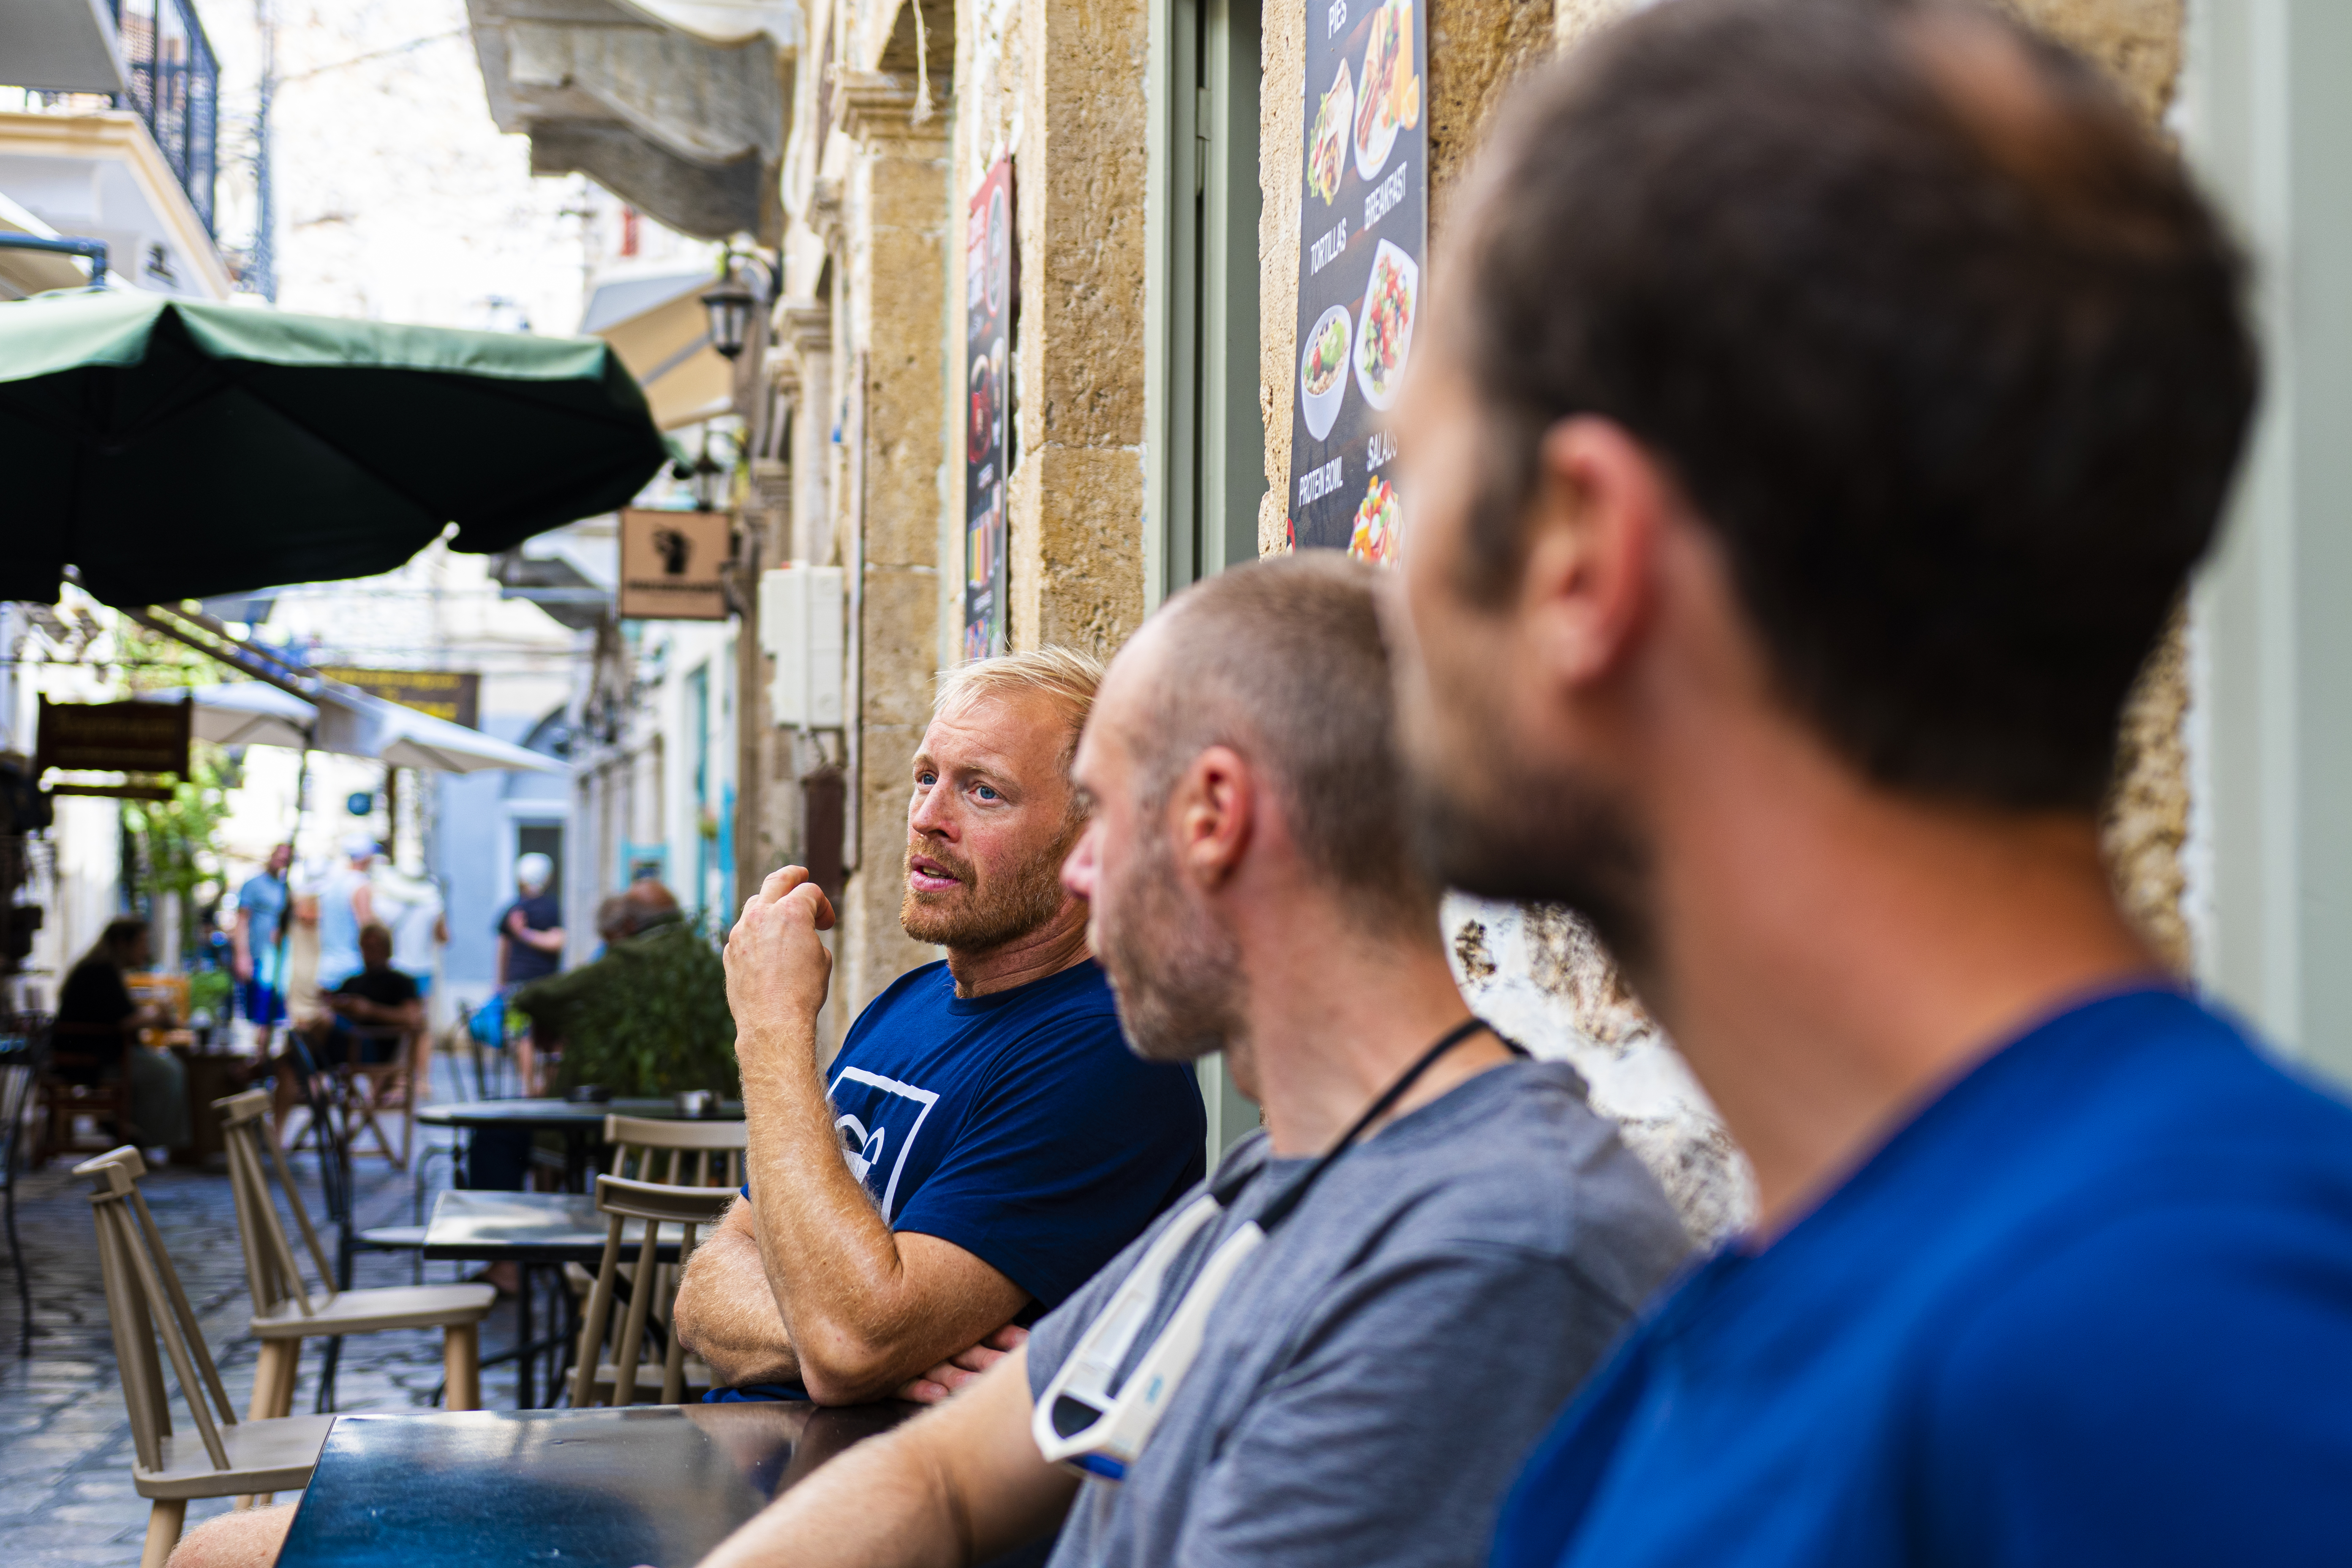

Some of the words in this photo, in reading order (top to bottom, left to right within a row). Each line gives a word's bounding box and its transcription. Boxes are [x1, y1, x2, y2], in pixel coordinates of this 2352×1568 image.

[1328, 0, 1346, 40] PIES
[1364, 161, 1407, 231] BREAKFAST
[1310, 217, 1347, 276] TORTILLAS
[1366, 427, 1397, 472] SALADS
[1298, 465, 1325, 507] PROTEIN
[1325, 456, 1343, 494] BOWL
